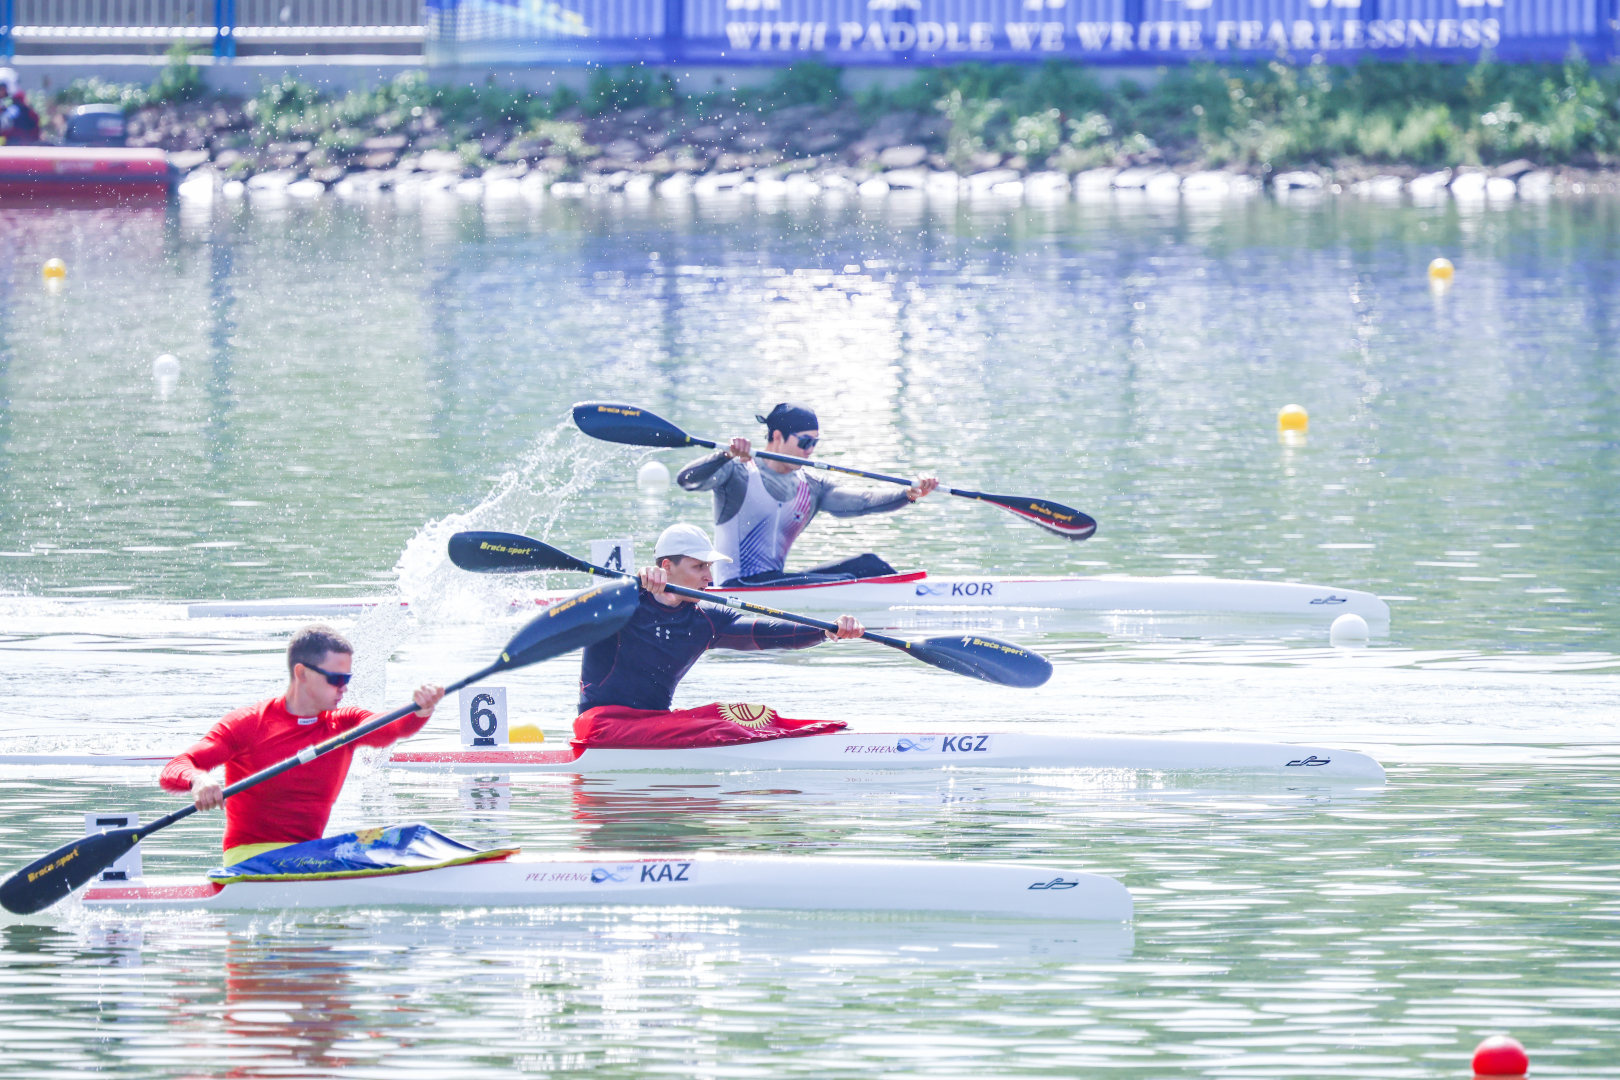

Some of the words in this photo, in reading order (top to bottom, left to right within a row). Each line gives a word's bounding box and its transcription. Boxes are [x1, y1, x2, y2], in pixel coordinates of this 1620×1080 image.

[726, 21, 827, 51] WITH
[840, 21, 994, 52] PADDLE
[1004, 21, 1065, 52] WE
[1076, 21, 1202, 51] WRITE
[1215, 18, 1500, 50] FEARLESSNESS
[952, 582, 993, 596] KOR
[470, 693, 498, 738] 6
[942, 735, 990, 752] KGZ
[640, 863, 691, 882] KAZ
